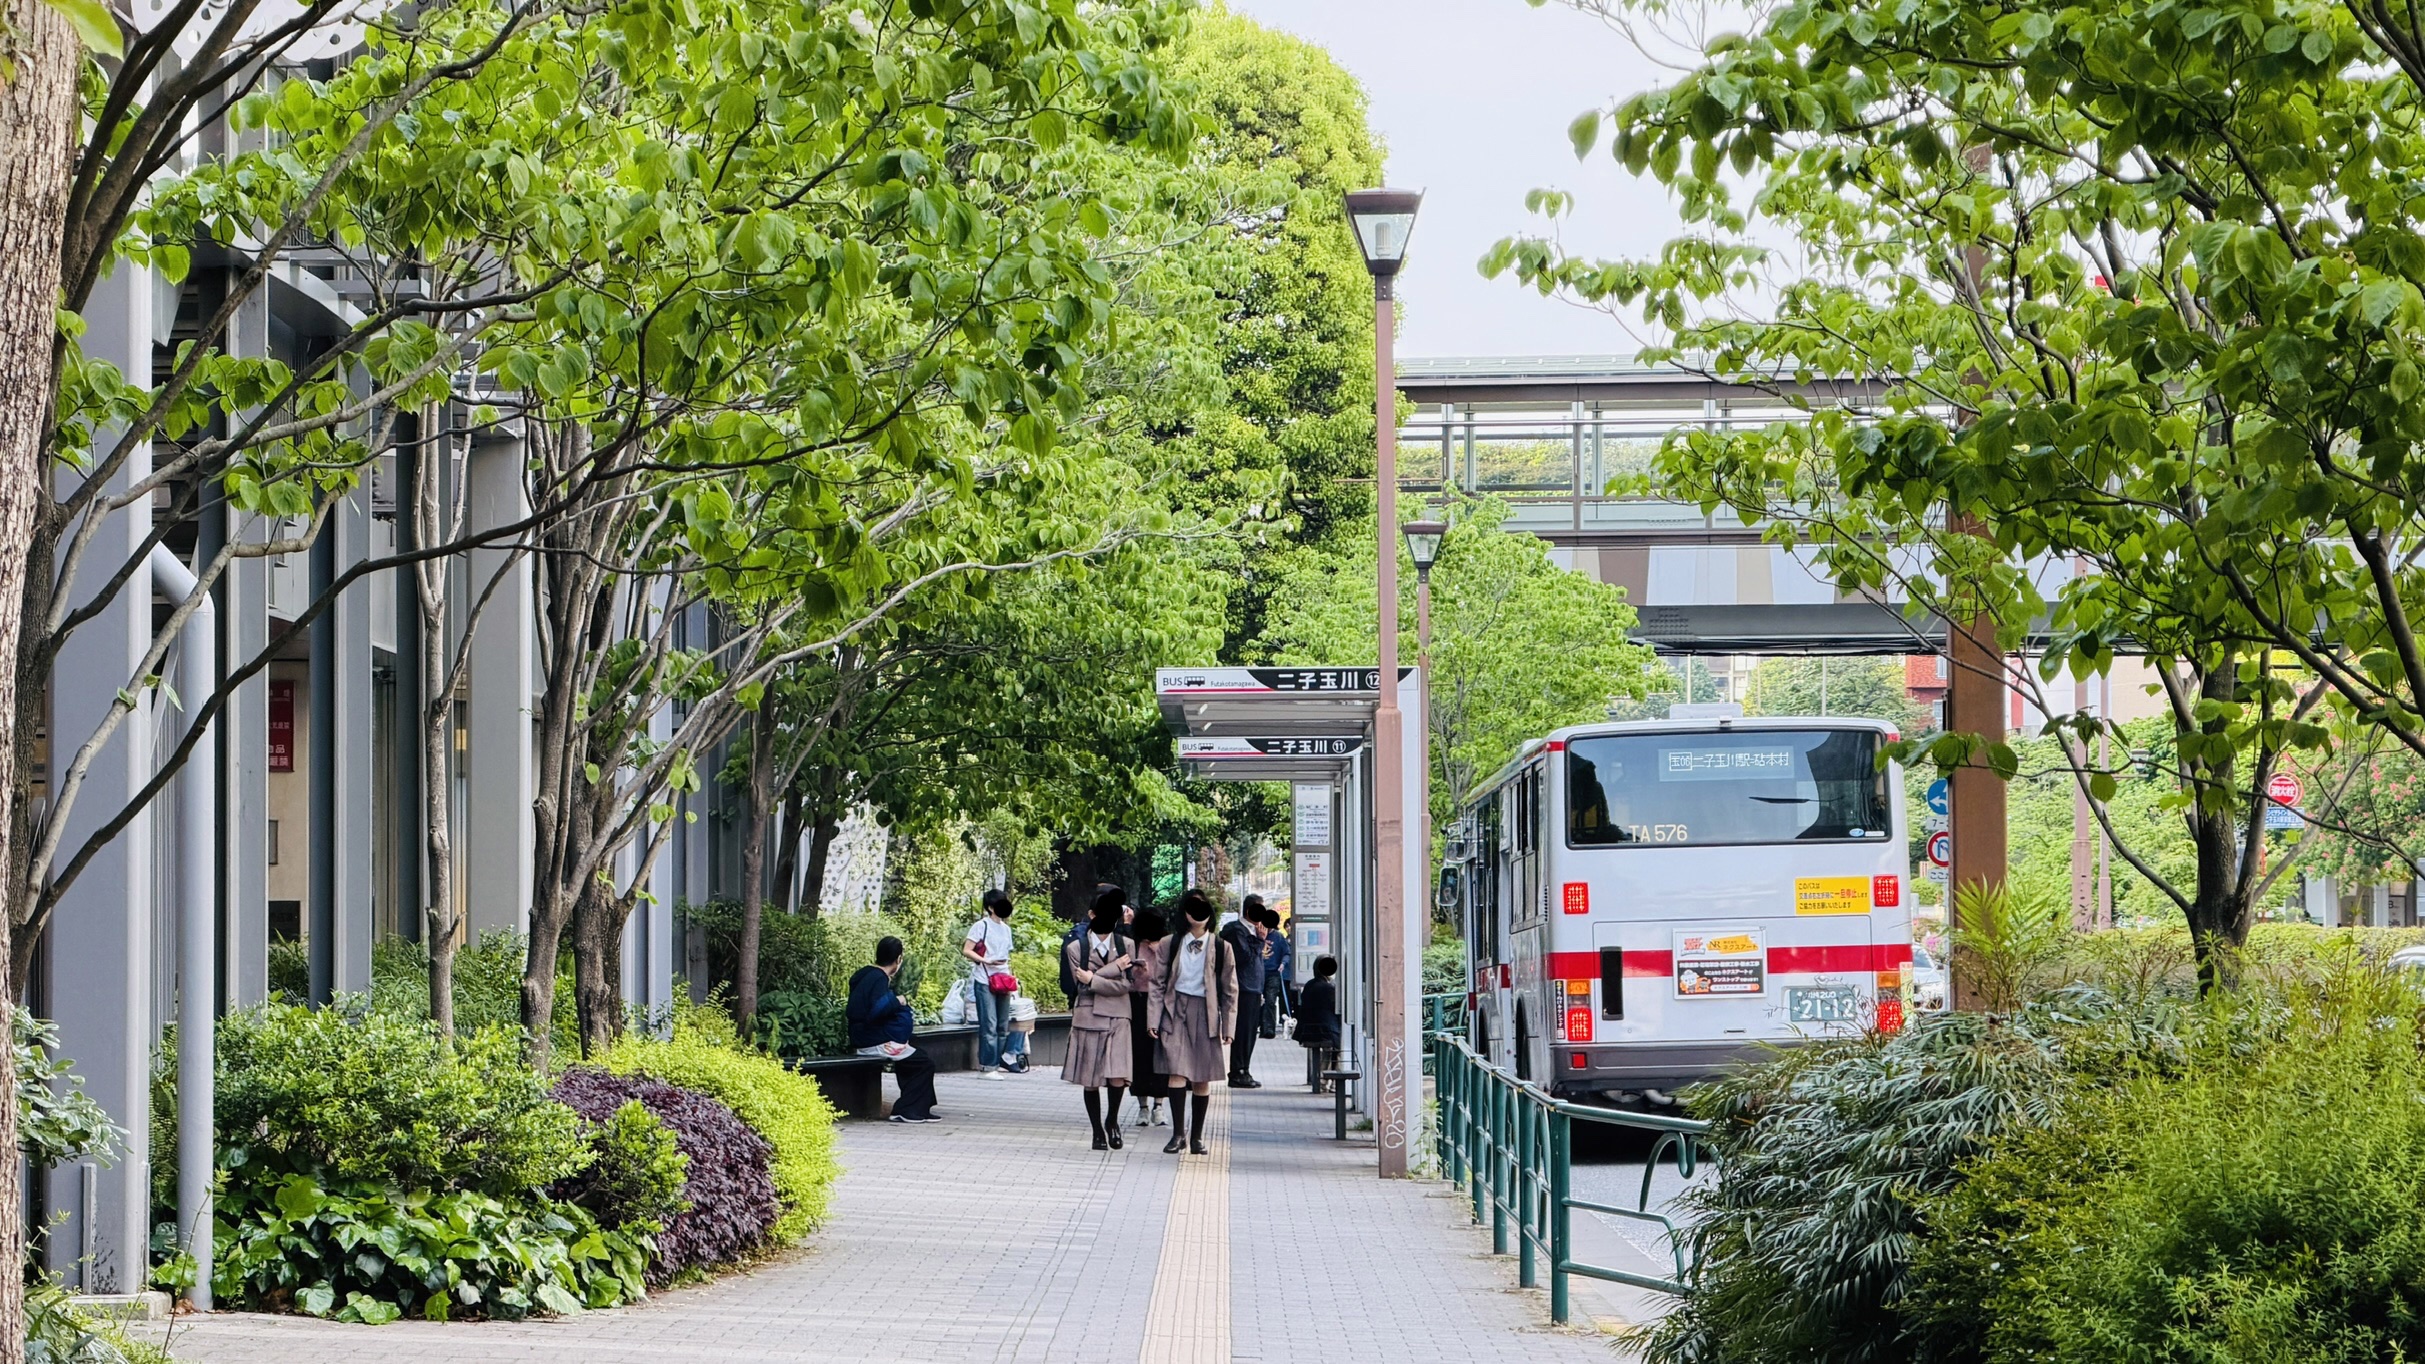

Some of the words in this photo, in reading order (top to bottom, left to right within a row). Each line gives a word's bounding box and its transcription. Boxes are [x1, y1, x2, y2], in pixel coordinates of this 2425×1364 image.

[1162, 677, 1183, 687] BUS
[1210, 680, 1256, 689] Futakotamagawa
[1277, 671, 1358, 690] 二子玉川
[1182, 743, 1198, 751] BUS
[1267, 740, 1328, 754] 二子玉川
[2271, 785, 2296, 797] 消火栓
[1628, 824, 1651, 843] TA
[1654, 823, 1688, 842] 576
[1800, 998, 1855, 1019] 21-12
